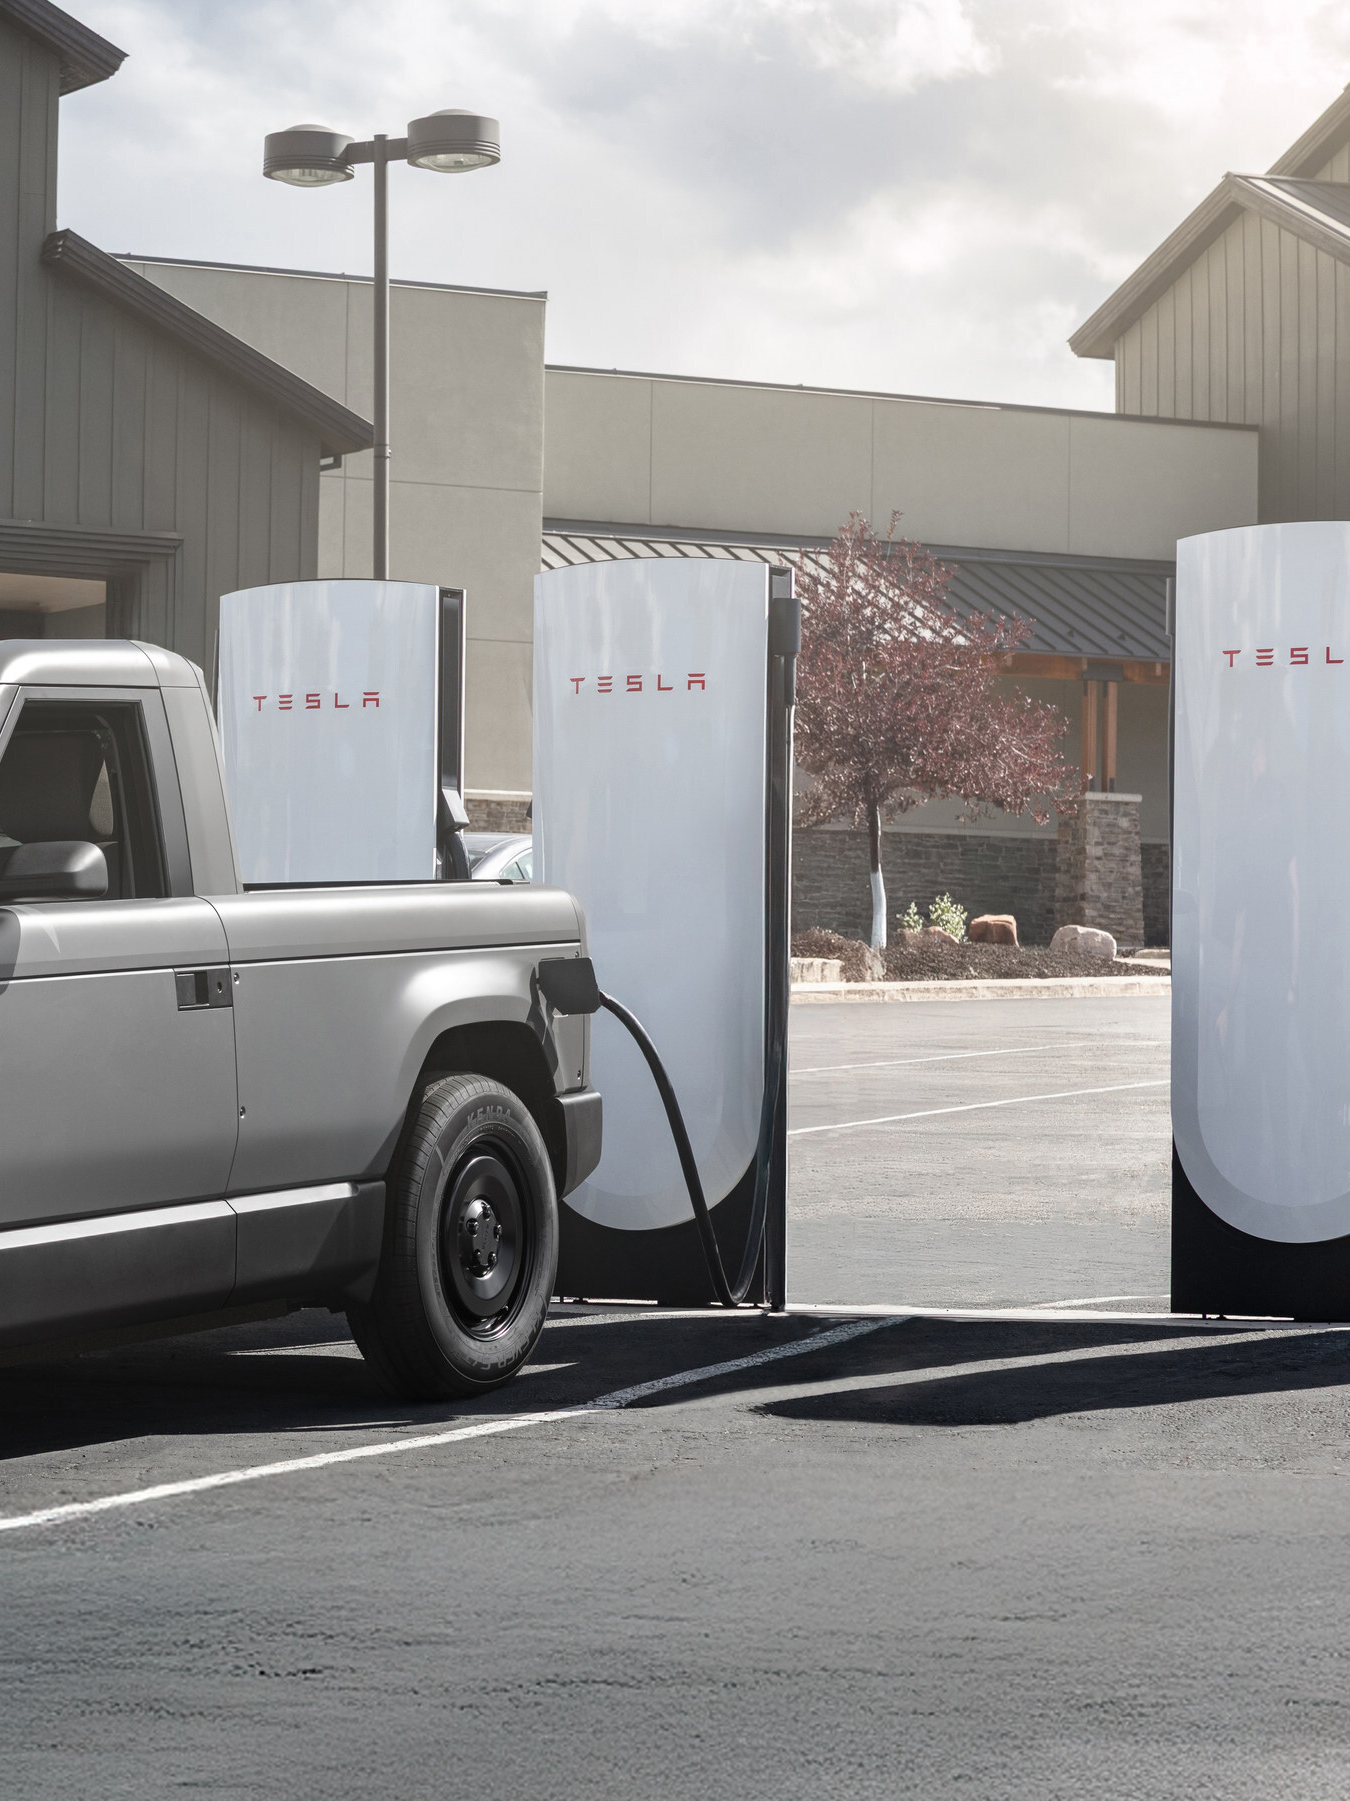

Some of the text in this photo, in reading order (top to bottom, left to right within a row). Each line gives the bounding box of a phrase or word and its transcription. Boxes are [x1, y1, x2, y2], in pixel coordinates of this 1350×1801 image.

[1223, 647, 1344, 668] TESL
[571, 673, 706, 696] TESLA
[253, 692, 380, 712] TESLA
[467, 1105, 511, 1129] KENDA
